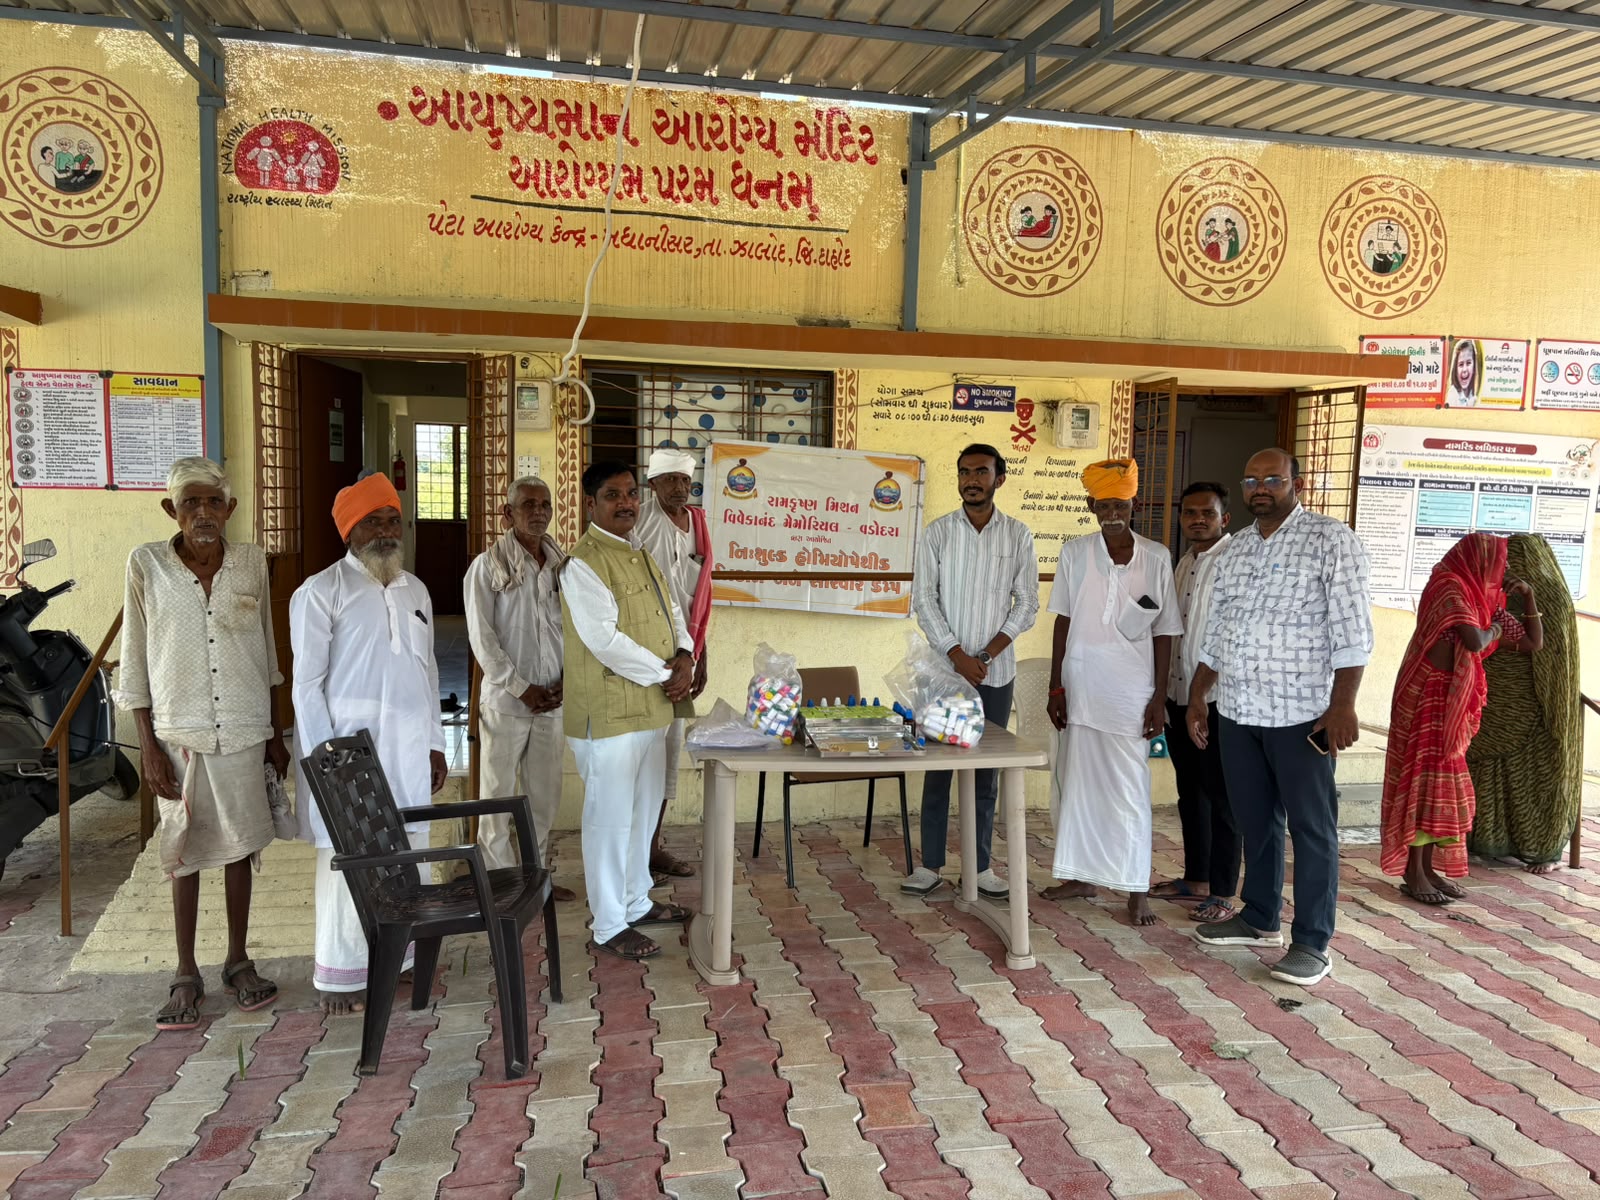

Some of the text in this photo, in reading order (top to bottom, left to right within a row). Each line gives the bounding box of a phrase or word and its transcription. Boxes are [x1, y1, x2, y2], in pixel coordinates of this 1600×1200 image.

[221, 107, 351, 182] NATIONAL HEALTH MISSION
[652, 96, 784, 159] આરોગ્ય
[794, 107, 878, 166] મંદિર
[652, 164, 719, 206] પરમ
[427, 199, 465, 236] પેટા
[473, 211, 544, 243] આરોગ્ય
[133, 377, 178, 387] સાવધાન
[971, 388, 980, 396] NO
[767, 495, 859, 514] રામકૃષ્ણ મિશન
[723, 508, 776, 528] વિવેકાનંદ
[783, 513, 839, 532] મેમોરિયલ
[859, 520, 900, 537] વડોદરા
[795, 546, 891, 571] હોમિયોપેથીક
